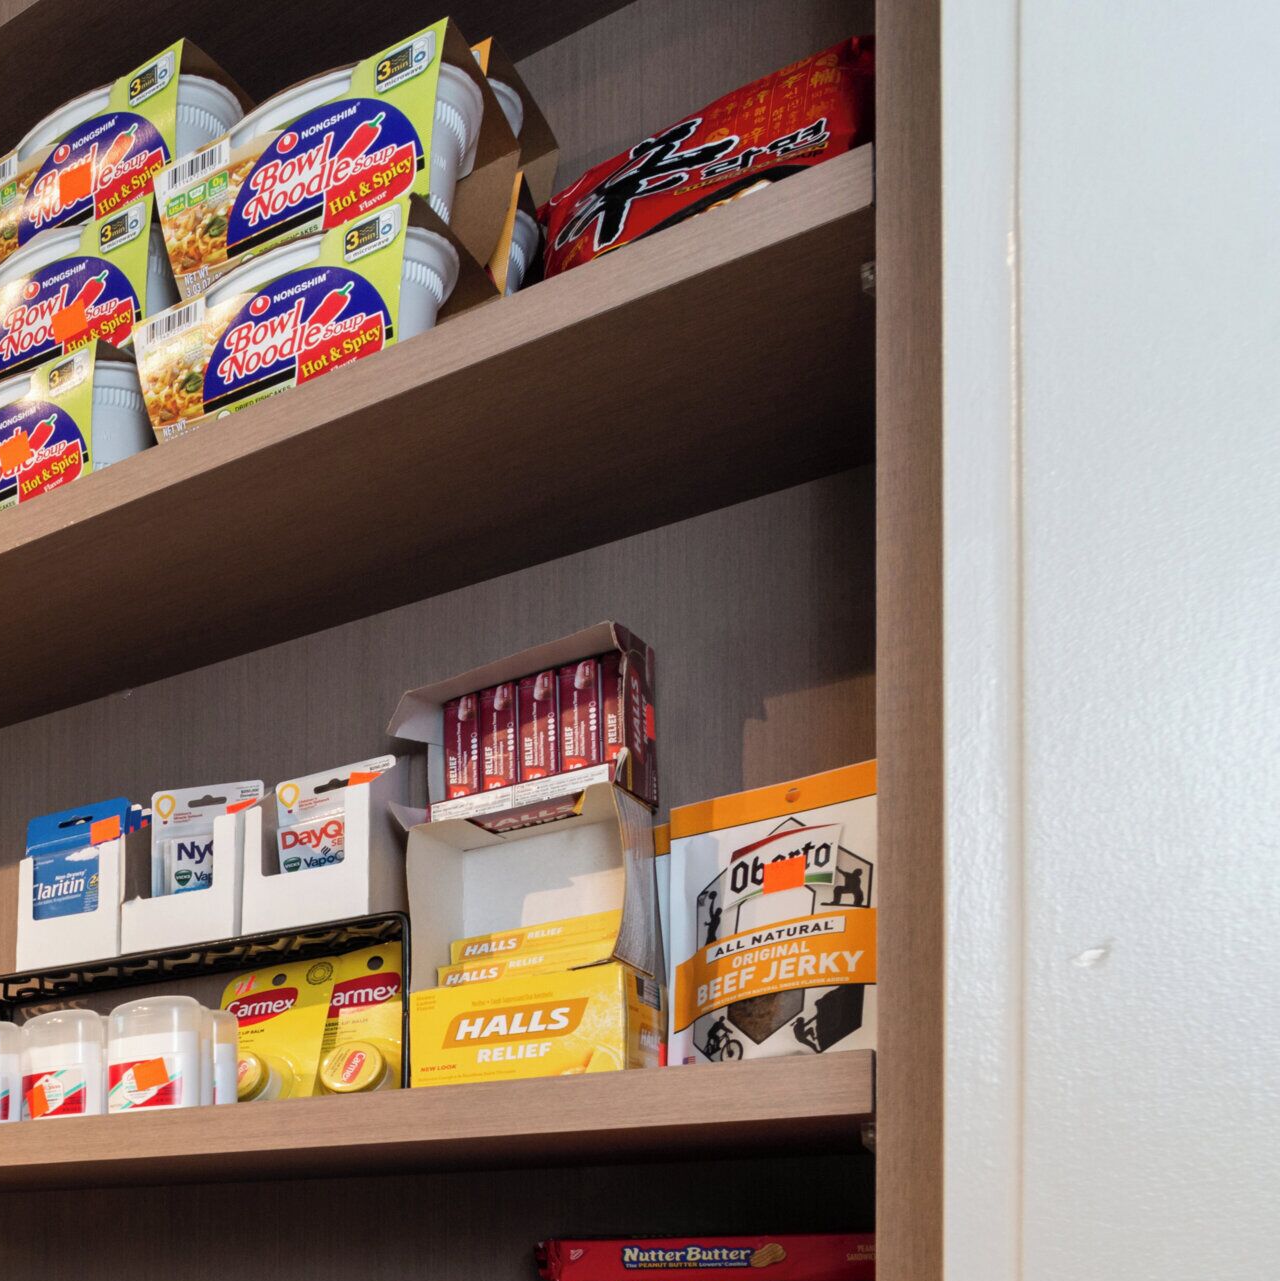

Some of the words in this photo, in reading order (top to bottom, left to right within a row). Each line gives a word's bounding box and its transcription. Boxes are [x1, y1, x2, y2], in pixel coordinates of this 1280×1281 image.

[378, 60, 391, 80] 3
[384, 64, 423, 87] microwave
[72, 119, 115, 150] NONGSHIM
[301, 105, 357, 139] NONGSHIM
[250, 132, 335, 195] Bowl
[98, 194, 121, 215] Hot
[121, 184, 131, 197] &
[131, 160, 162, 185] Spicy
[243, 157, 351, 226] Noodle
[329, 191, 357, 215] Hot
[359, 182, 371, 197] &
[371, 156, 412, 188] Spicy
[359, 191, 388, 211] Flavor
[101, 226, 112, 242] 3
[346, 231, 359, 250] 3
[353, 237, 389, 258] microwave
[42, 263, 86, 288] NONGSHIM
[273, 273, 327, 303] NONGSHIM
[4, 284, 67, 333] Bowl
[89, 327, 100, 340] &
[100, 310, 132, 333] Spicy
[225, 297, 305, 356] Bowl
[218, 323, 321, 384] Noodle
[301, 354, 328, 378] Hot
[329, 346, 342, 360] &
[343, 325, 381, 353] Spicy
[22, 477, 41, 495] Hot
[42, 469, 52, 482] &
[52, 451, 79, 475] Spicy
[44, 477, 63, 492] Flavor
[608, 713, 616, 743] RELIEF
[484, 747, 492, 775] RELIEF
[465, 938, 517, 957] HALLS
[527, 927, 563, 939] RELIEF
[714, 941, 745, 957] ALL
[751, 920, 834, 945] NATURAL
[446, 967, 498, 985] HALLS
[509, 956, 544, 968] RELIEF
[732, 942, 809, 969] ORIGINAL
[697, 966, 754, 1007] BEEF
[761, 951, 864, 983] JERKY
[226, 999, 294, 1018] Carmex
[330, 985, 397, 1007] armex
[455, 1008, 570, 1041] HALLS
[343, 1051, 366, 1082] Carmex
[477, 1042, 551, 1064] RELIEF
[624, 1247, 685, 1263] Nutter
[687, 1247, 751, 1262] Butter
